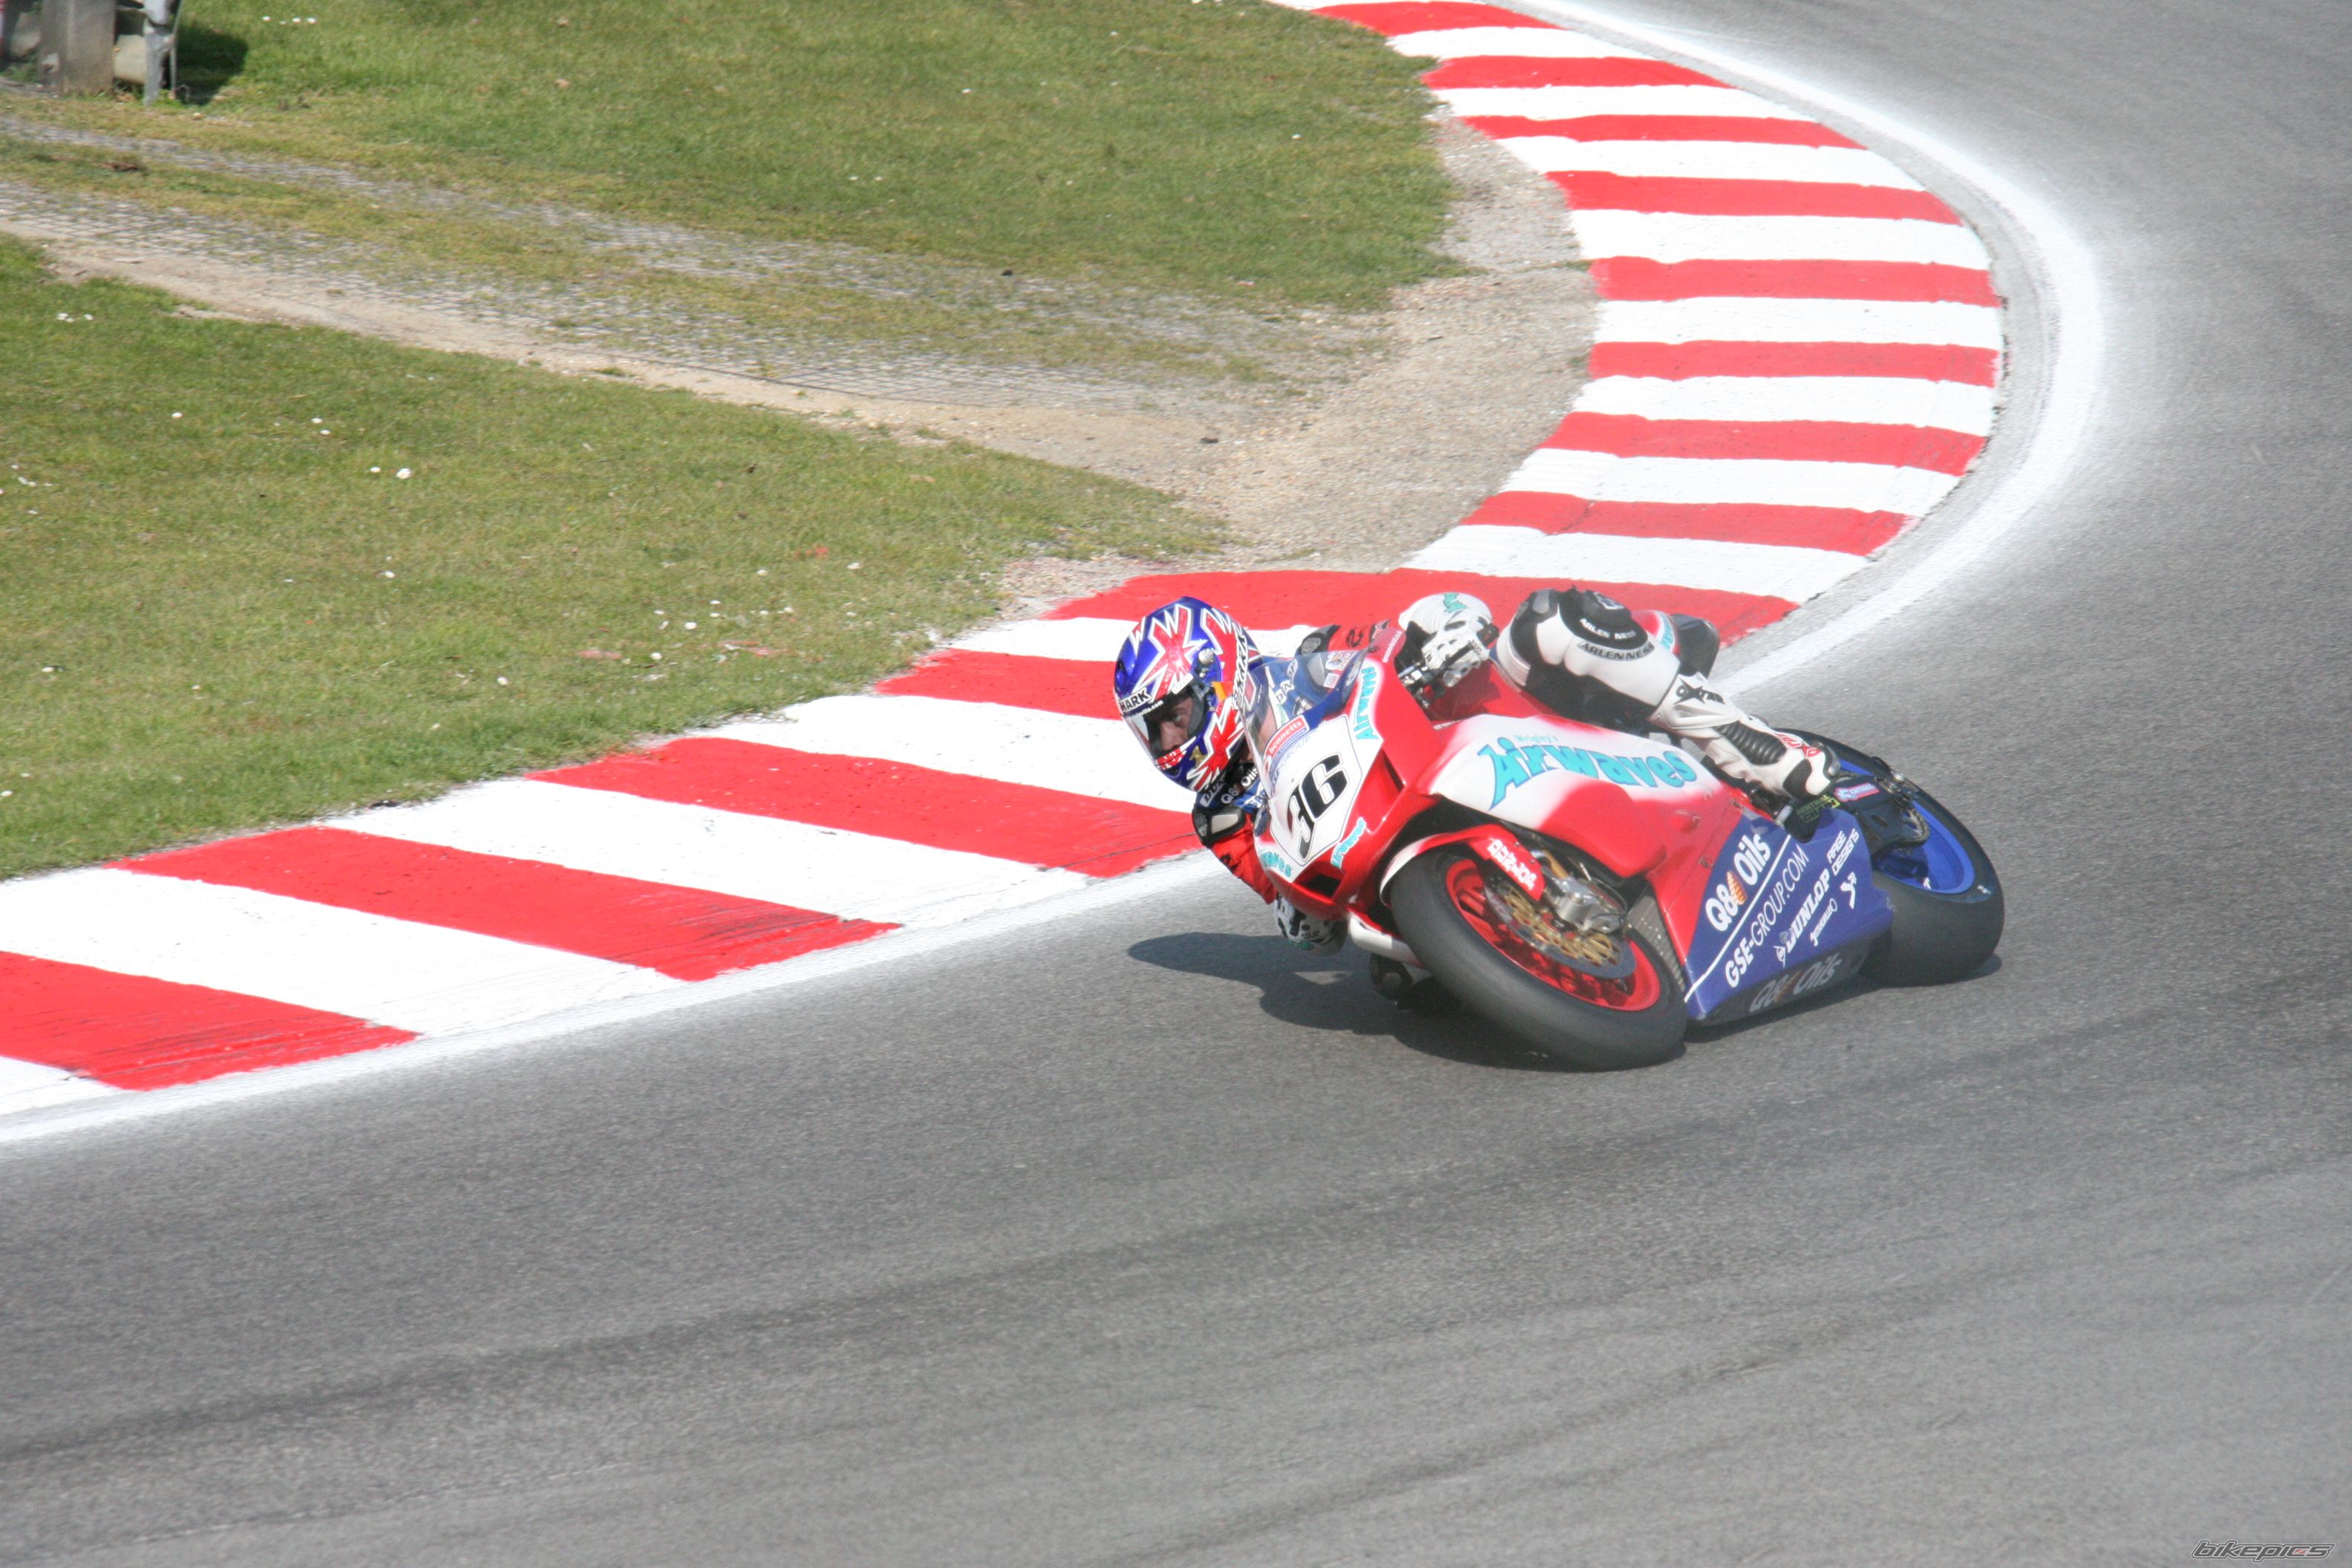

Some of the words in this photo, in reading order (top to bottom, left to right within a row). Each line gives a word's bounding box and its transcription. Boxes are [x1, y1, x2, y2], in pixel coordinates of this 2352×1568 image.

[1118, 687, 1151, 712] HARK
[1268, 719, 1303, 754] bennetts
[1477, 736, 1697, 811] Airwaves
[1705, 883, 1739, 932] Q8
[1734, 833, 1771, 886] Oils
[1832, 828, 1860, 877] DESIGNS
[1725, 843, 1809, 987] GSE-GROUP.COM
